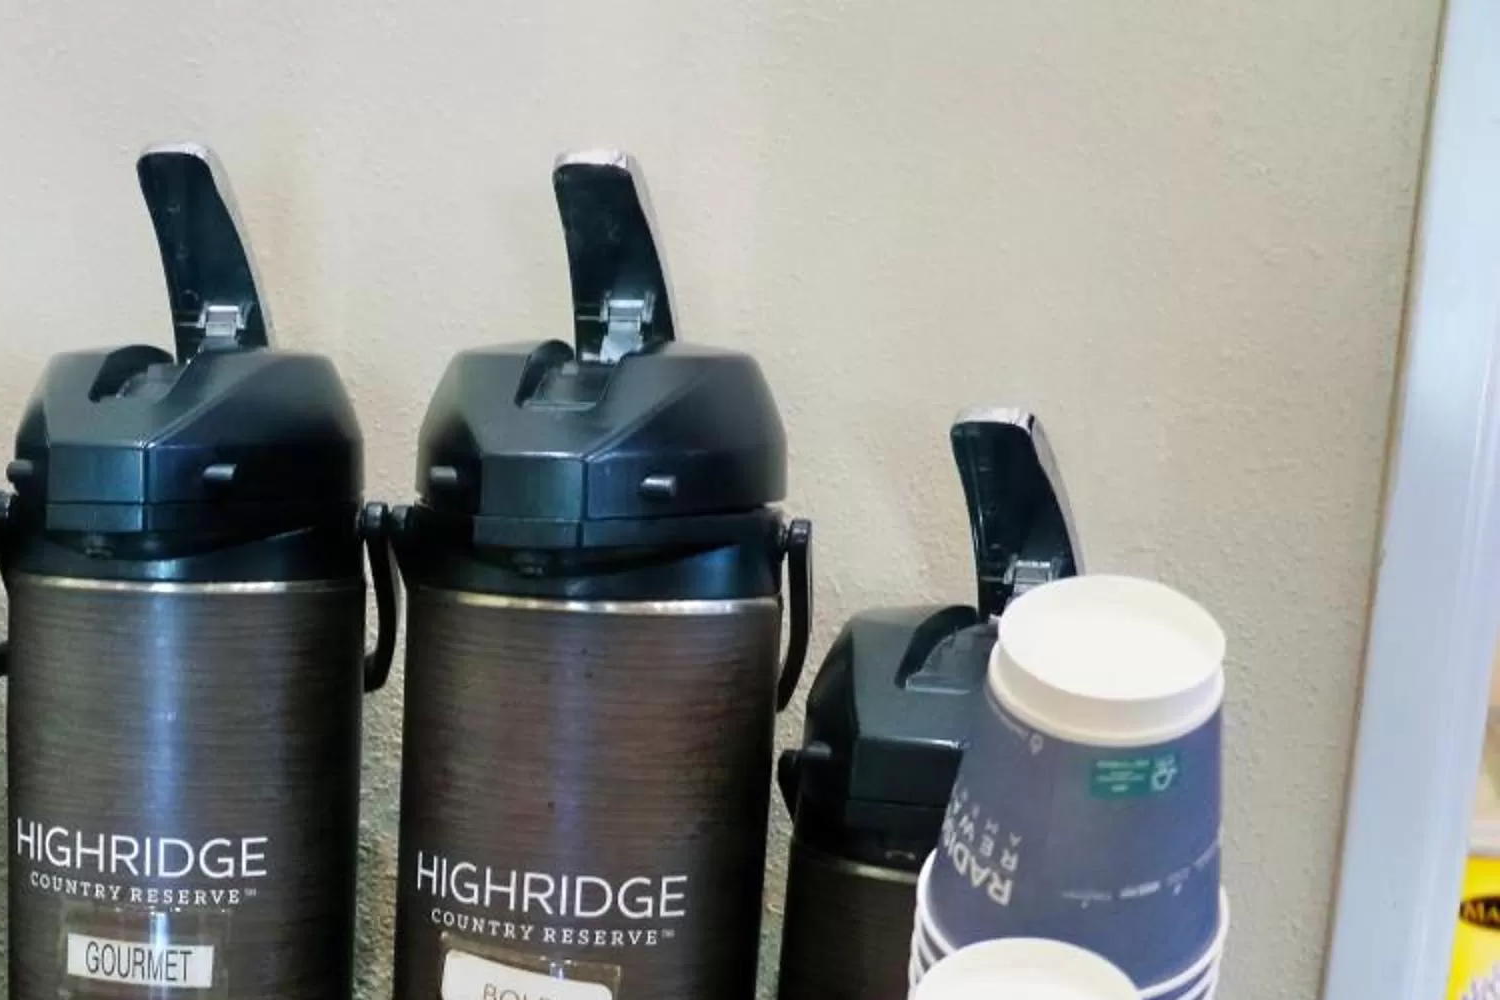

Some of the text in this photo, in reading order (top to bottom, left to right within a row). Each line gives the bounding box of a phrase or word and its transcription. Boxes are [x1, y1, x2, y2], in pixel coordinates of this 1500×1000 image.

[17, 817, 269, 879] HIGHRIDGE
[30, 871, 242, 905] COUNTRY RESERVE
[416, 850, 688, 919] HIGHRIDGE
[431, 907, 658, 946] COUNTRY RESERVE
[85, 941, 193, 982] GOURMET
